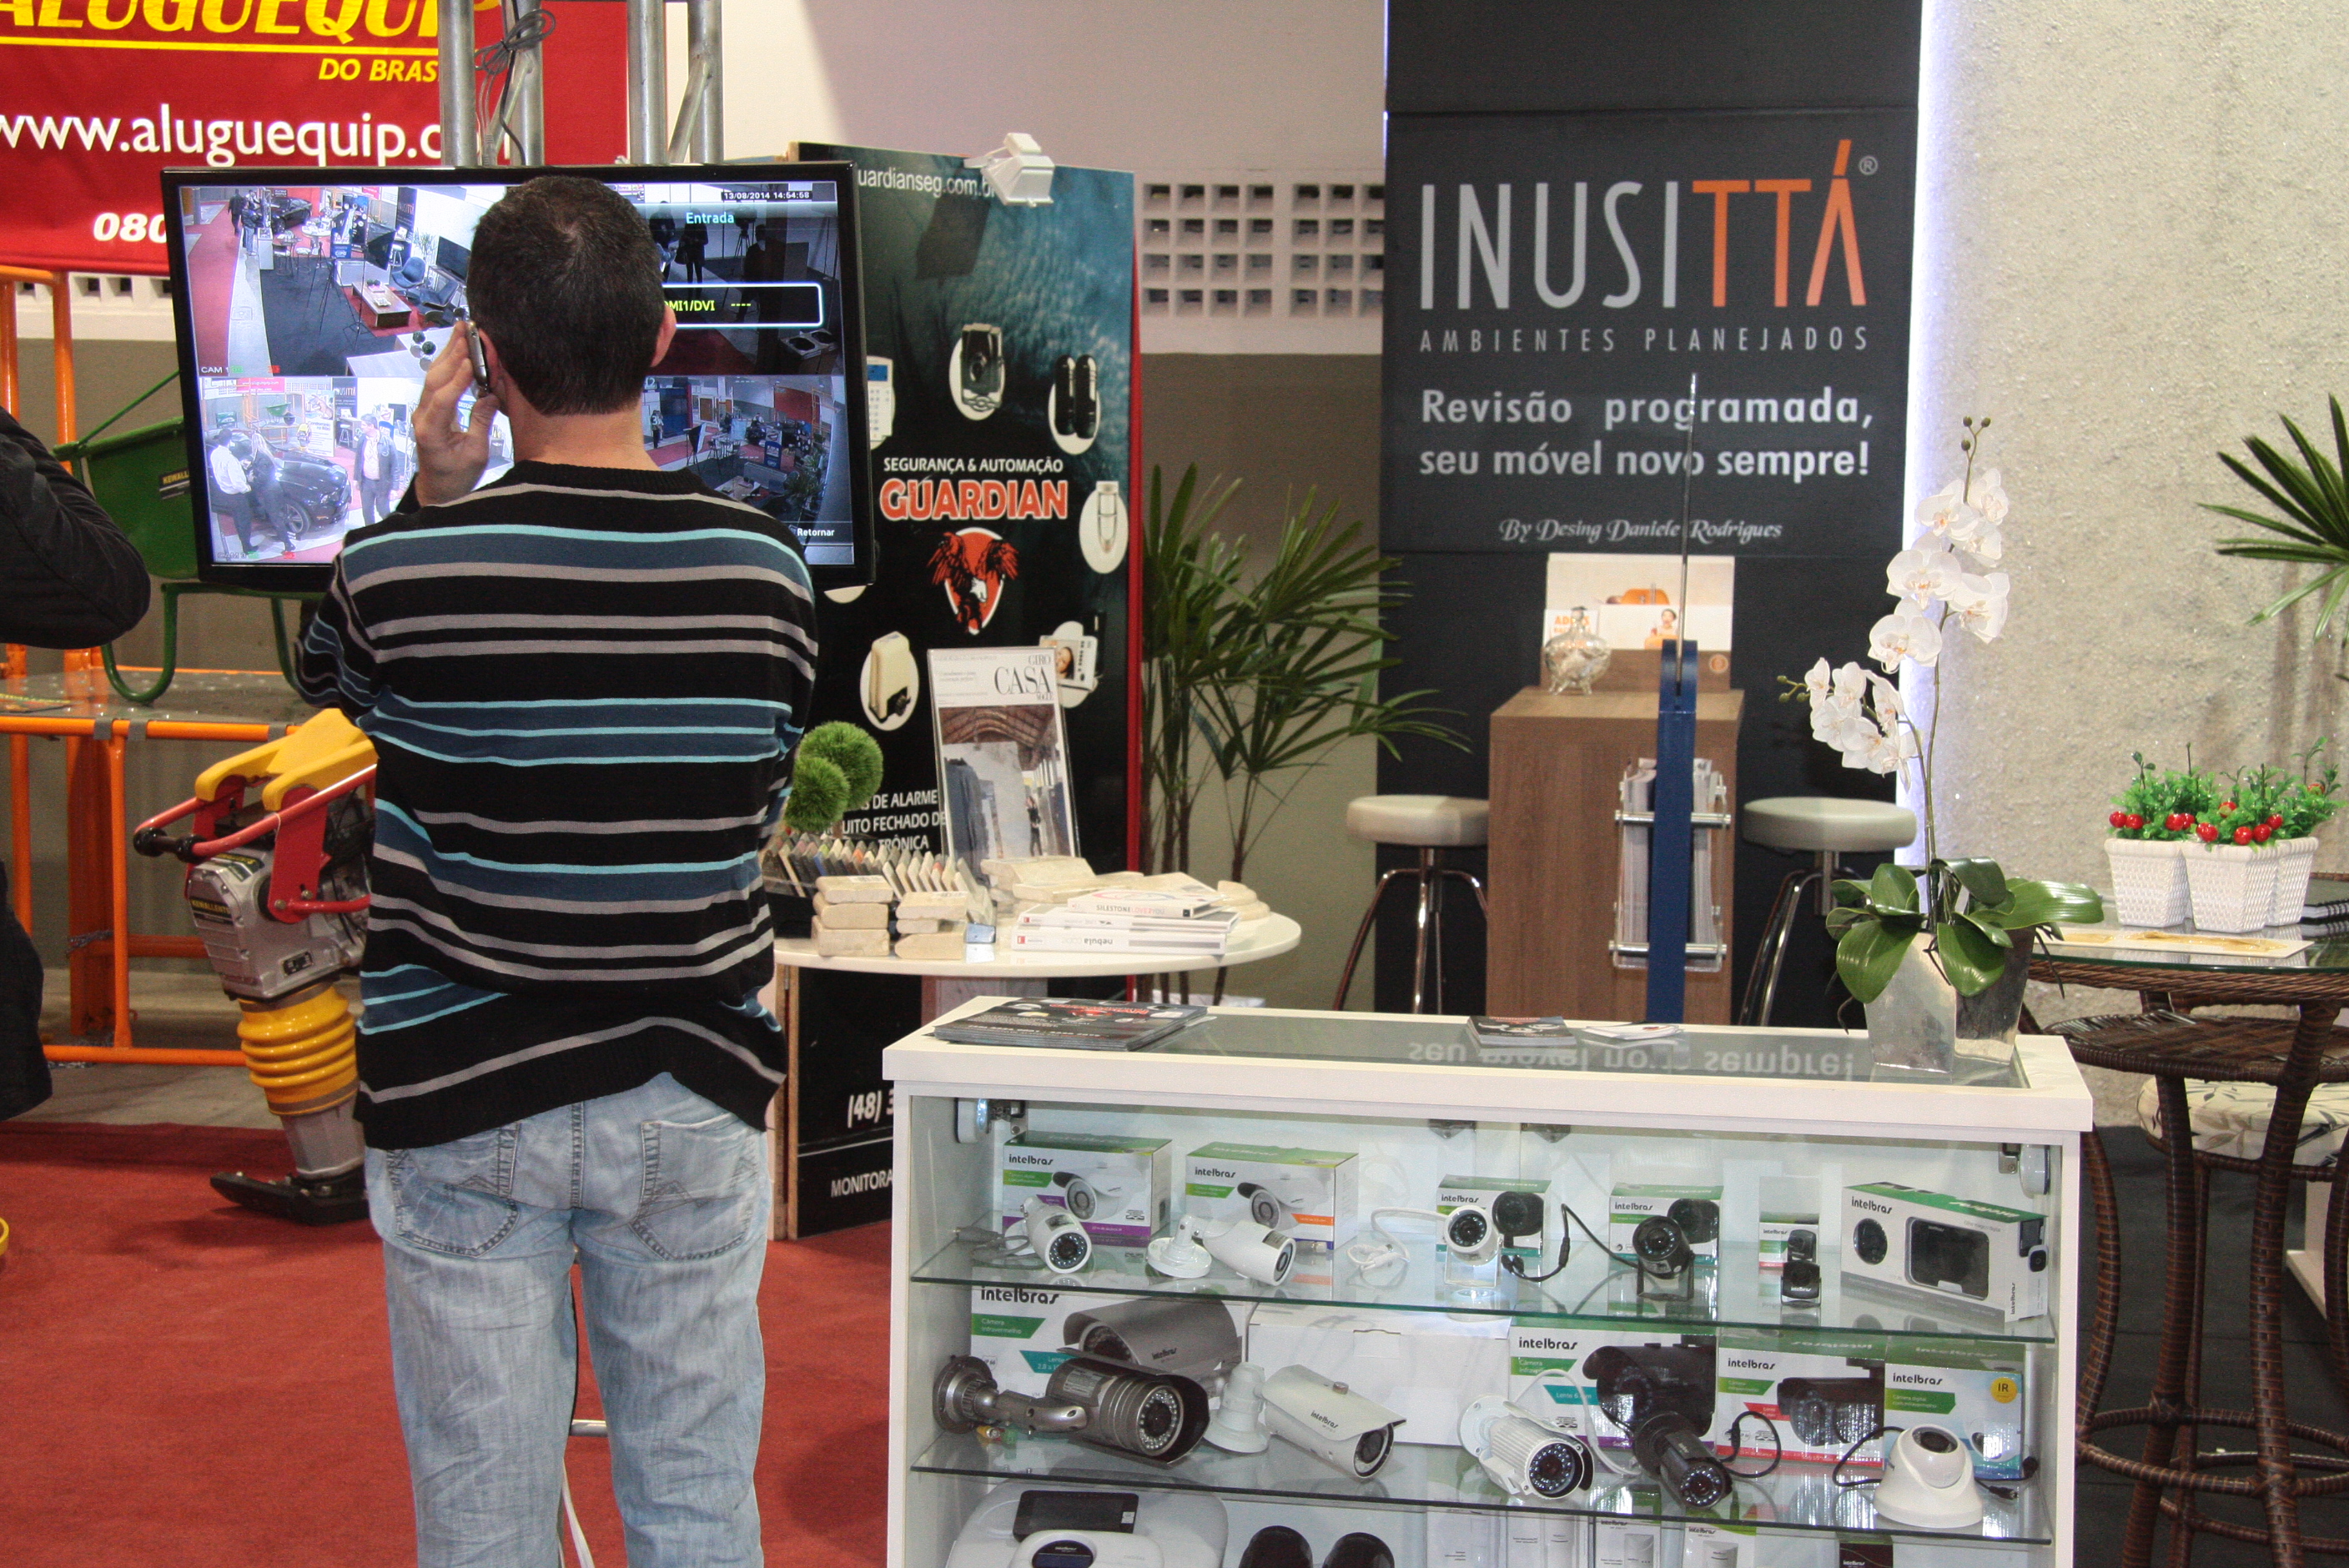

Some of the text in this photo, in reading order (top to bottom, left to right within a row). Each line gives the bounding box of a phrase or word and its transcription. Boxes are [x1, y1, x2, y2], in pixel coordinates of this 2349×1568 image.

[319, 58, 361, 80] DO
[773, 191, 810, 199] 14:54:58
[686, 212, 735, 224] Entrada
[1421, 139, 1867, 309] INUSITTÁ
[1420, 326, 1867, 353] AMBIENTES PLANEJADOS
[1421, 386, 1874, 430] Revisão programada,
[883, 456, 1064, 475] SEGURANÇA & AUTOMAÇÃO
[1420, 440, 1869, 484] seu móvel novo sempre!
[880, 478, 1069, 521] GUARDIAN
[797, 527, 835, 536] Retornar
[1499, 519, 1783, 545] By Desing Daniele Rodrigues
[994, 666, 1052, 695] CASA
[873, 793, 888, 810] DE
[890, 789, 938, 808] ALARME
[873, 812, 929, 832] FECHADO
[848, 1089, 883, 1129] (48)
[1009, 1153, 1054, 1166] intelbras
[1195, 1167, 1235, 1179] intelbras
[1441, 1194, 1479, 1204] intelbras
[1614, 1202, 1653, 1211] intelbras
[1851, 1196, 1893, 1215] intelbras
[981, 1285, 1059, 1305] intelbras
[1518, 1337, 1578, 1350] intelbras
[1728, 1358, 1776, 1370] intelbras
[1893, 1373, 1944, 1385] intelbras
[1998, 1383, 2009, 1393] IR
[1310, 1410, 1339, 1429] intelbras
